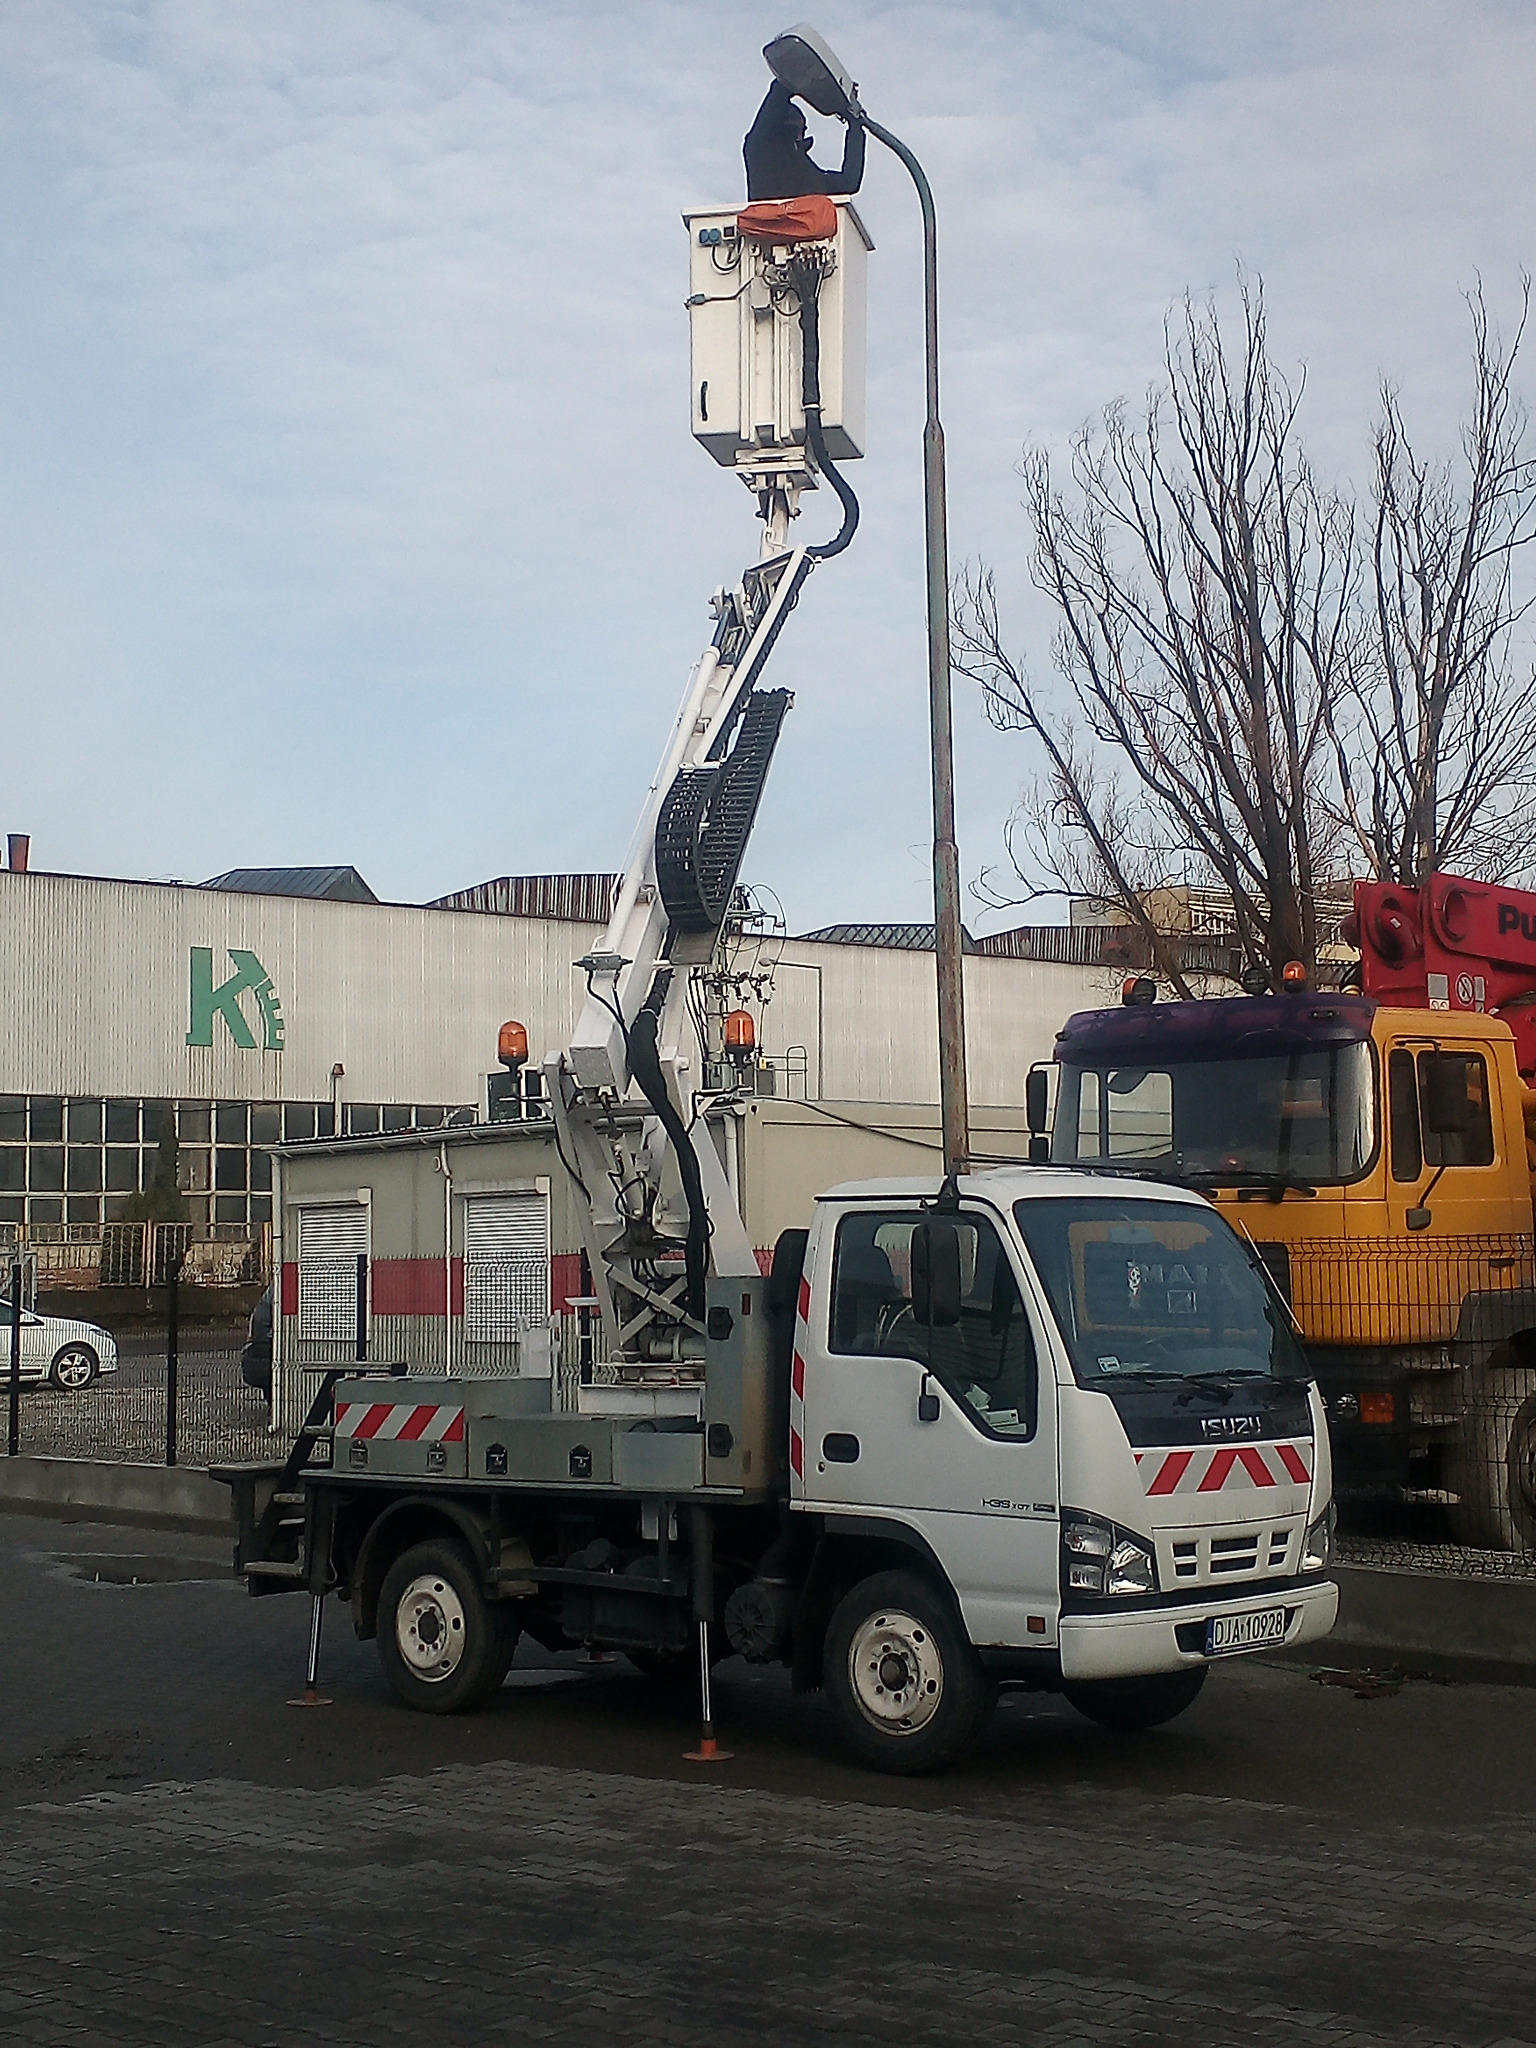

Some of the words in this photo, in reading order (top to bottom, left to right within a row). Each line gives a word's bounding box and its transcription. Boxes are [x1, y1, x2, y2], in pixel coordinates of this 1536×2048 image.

[1201, 1416, 1262, 1437] ISUZU
[1215, 1618, 1240, 1645] DJA
[1246, 1611, 1283, 1641] 10928
